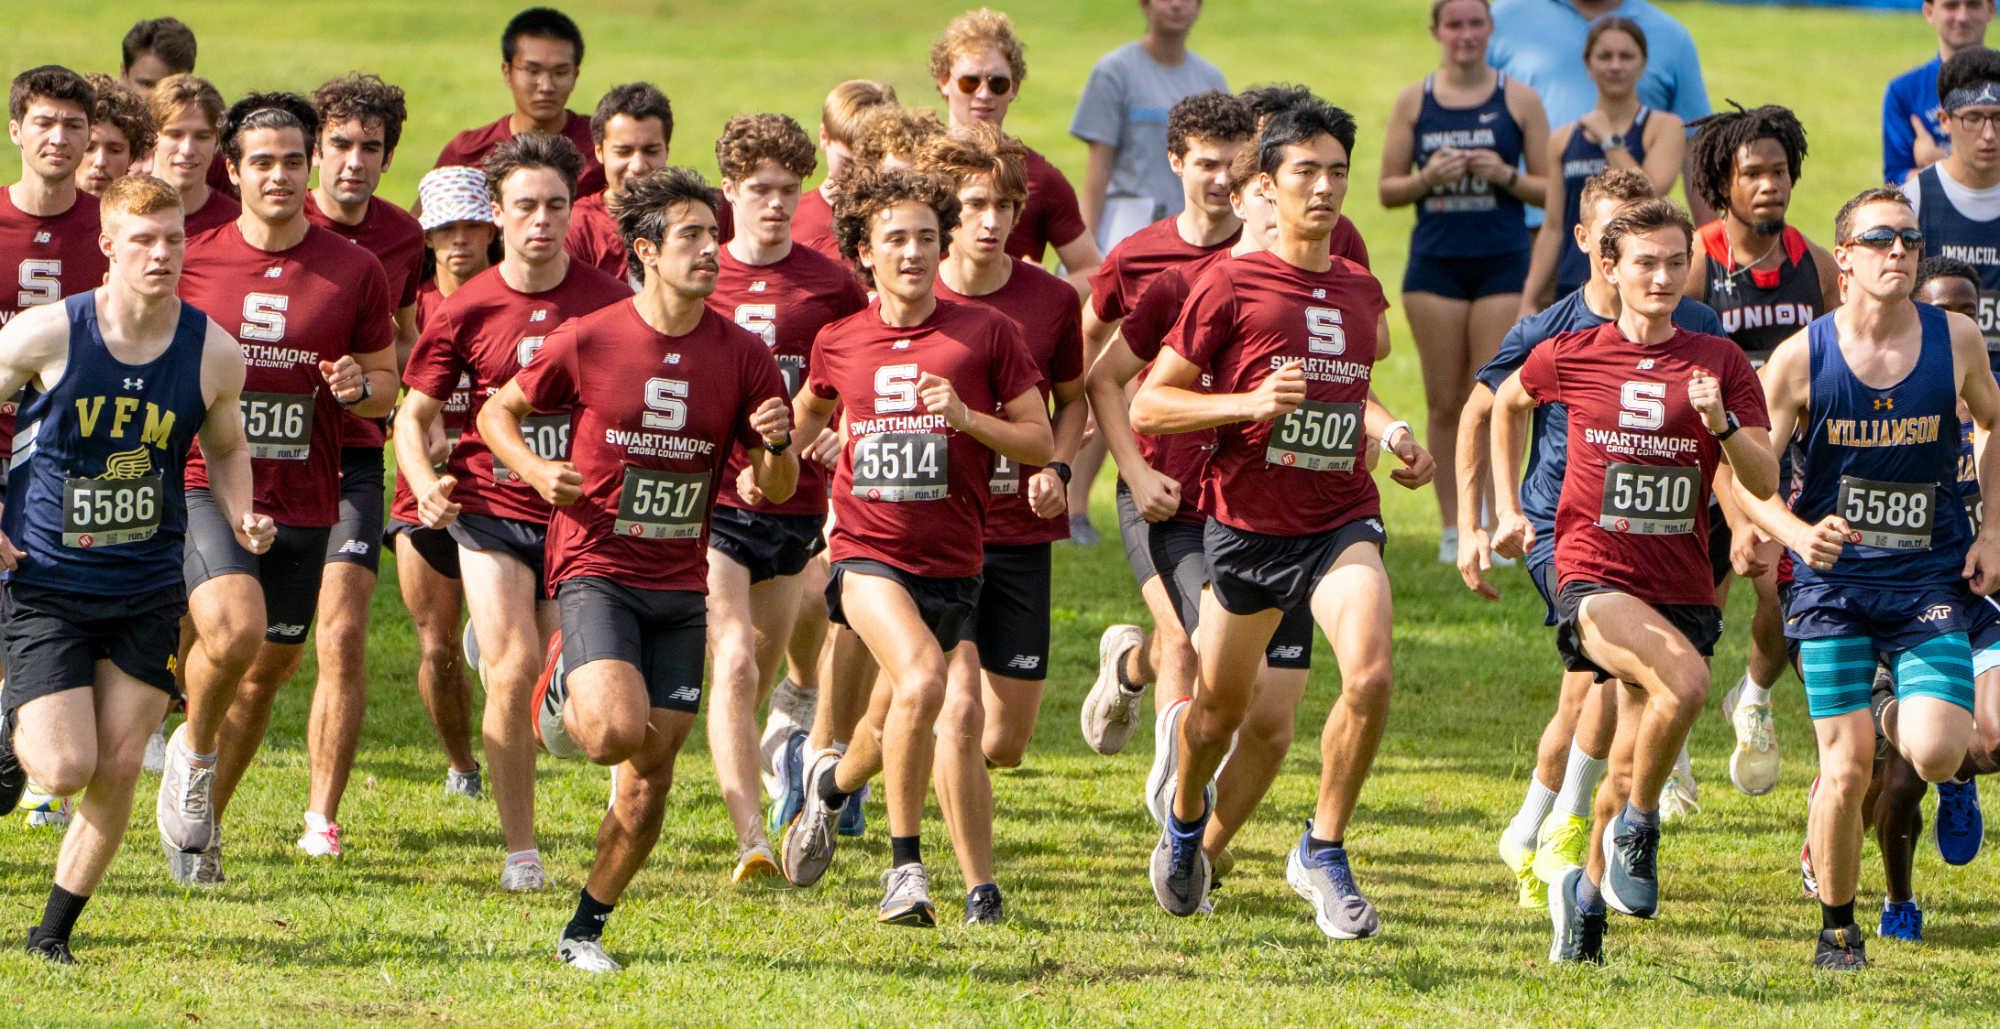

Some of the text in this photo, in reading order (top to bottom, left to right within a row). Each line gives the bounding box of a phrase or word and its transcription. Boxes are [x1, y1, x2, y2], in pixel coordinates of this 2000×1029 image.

[1942, 245, 2000, 266] IMMACUL
[18, 259, 62, 307] S
[240, 292, 288, 342] S
[1722, 303, 1813, 334] UNION
[1304, 306, 1346, 356] S
[240, 344, 318, 365] RTHMORE
[255, 359, 295, 370] COUNTRY
[874, 363, 918, 414] S
[1320, 373, 1355, 385] COUNTRY
[444, 404, 467, 412] ROSS
[642, 377, 689, 431] S
[1618, 380, 1666, 431] S
[850, 414, 950, 436] SWARTHMOR
[1281, 408, 1357, 450] 5502
[1827, 415, 1941, 447] WILLIAMSON
[278, 448, 301, 457] run.tf
[520, 424, 570, 460] 508
[605, 428, 715, 455] SWARTHMORE
[627, 446, 695, 460] CROSS COUNTRY
[1585, 428, 1698, 453] SWARTHMORE
[1606, 445, 1677, 459] CROSS COUNTRY
[862, 442, 939, 480] 5514
[1327, 460, 1348, 470] run.tf
[633, 478, 702, 518] 5517
[915, 489, 939, 499] run.tf
[991, 483, 1010, 493] un.tf
[1614, 472, 1691, 513] 5510
[73, 487, 154, 526] 5586
[1846, 487, 1927, 528] 5588
[128, 529, 153, 541] run.tf
[674, 526, 694, 537] run.tf
[1664, 522, 1687, 533] run.tf
[1898, 539, 1922, 548] run.tf
